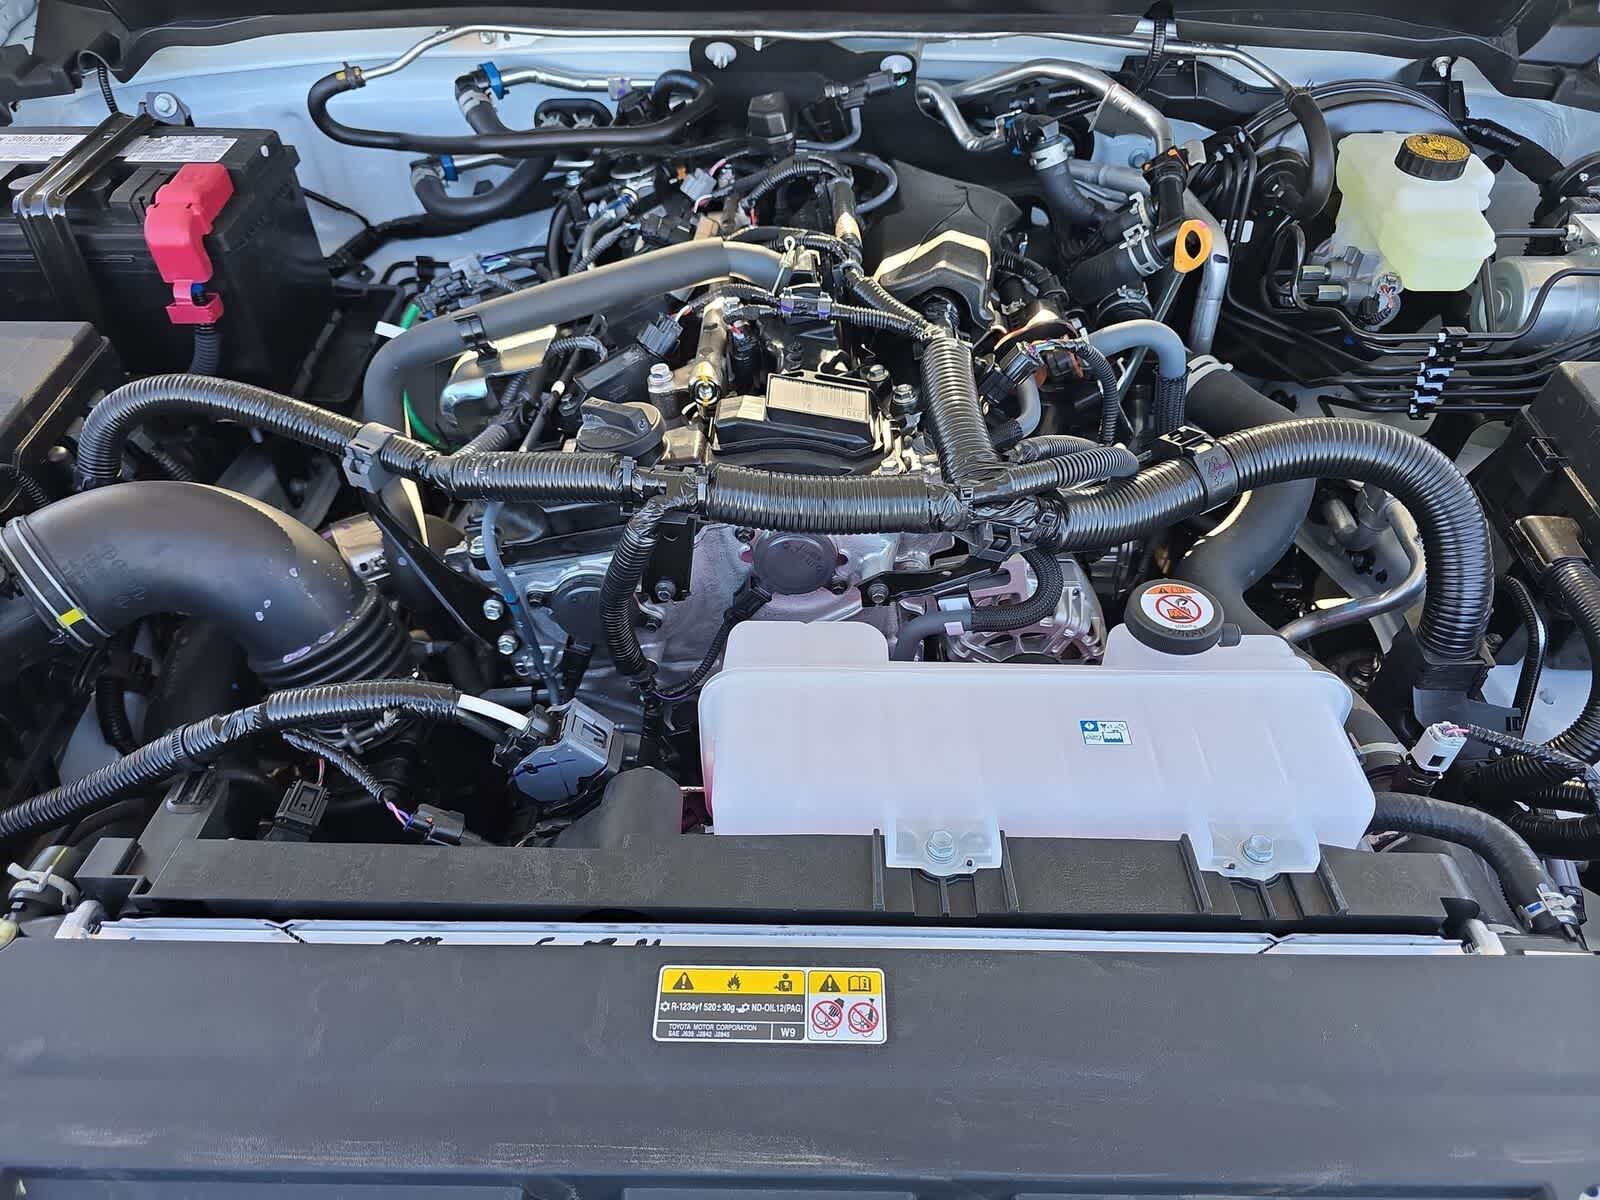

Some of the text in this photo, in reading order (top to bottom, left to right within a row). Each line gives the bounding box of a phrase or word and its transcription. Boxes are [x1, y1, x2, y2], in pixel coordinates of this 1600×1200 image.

[671, 1002, 702, 1012] R-1234yf
[751, 1003, 804, 1015] ND-OIL12(PAG)
[780, 1027, 796, 1038] W9
